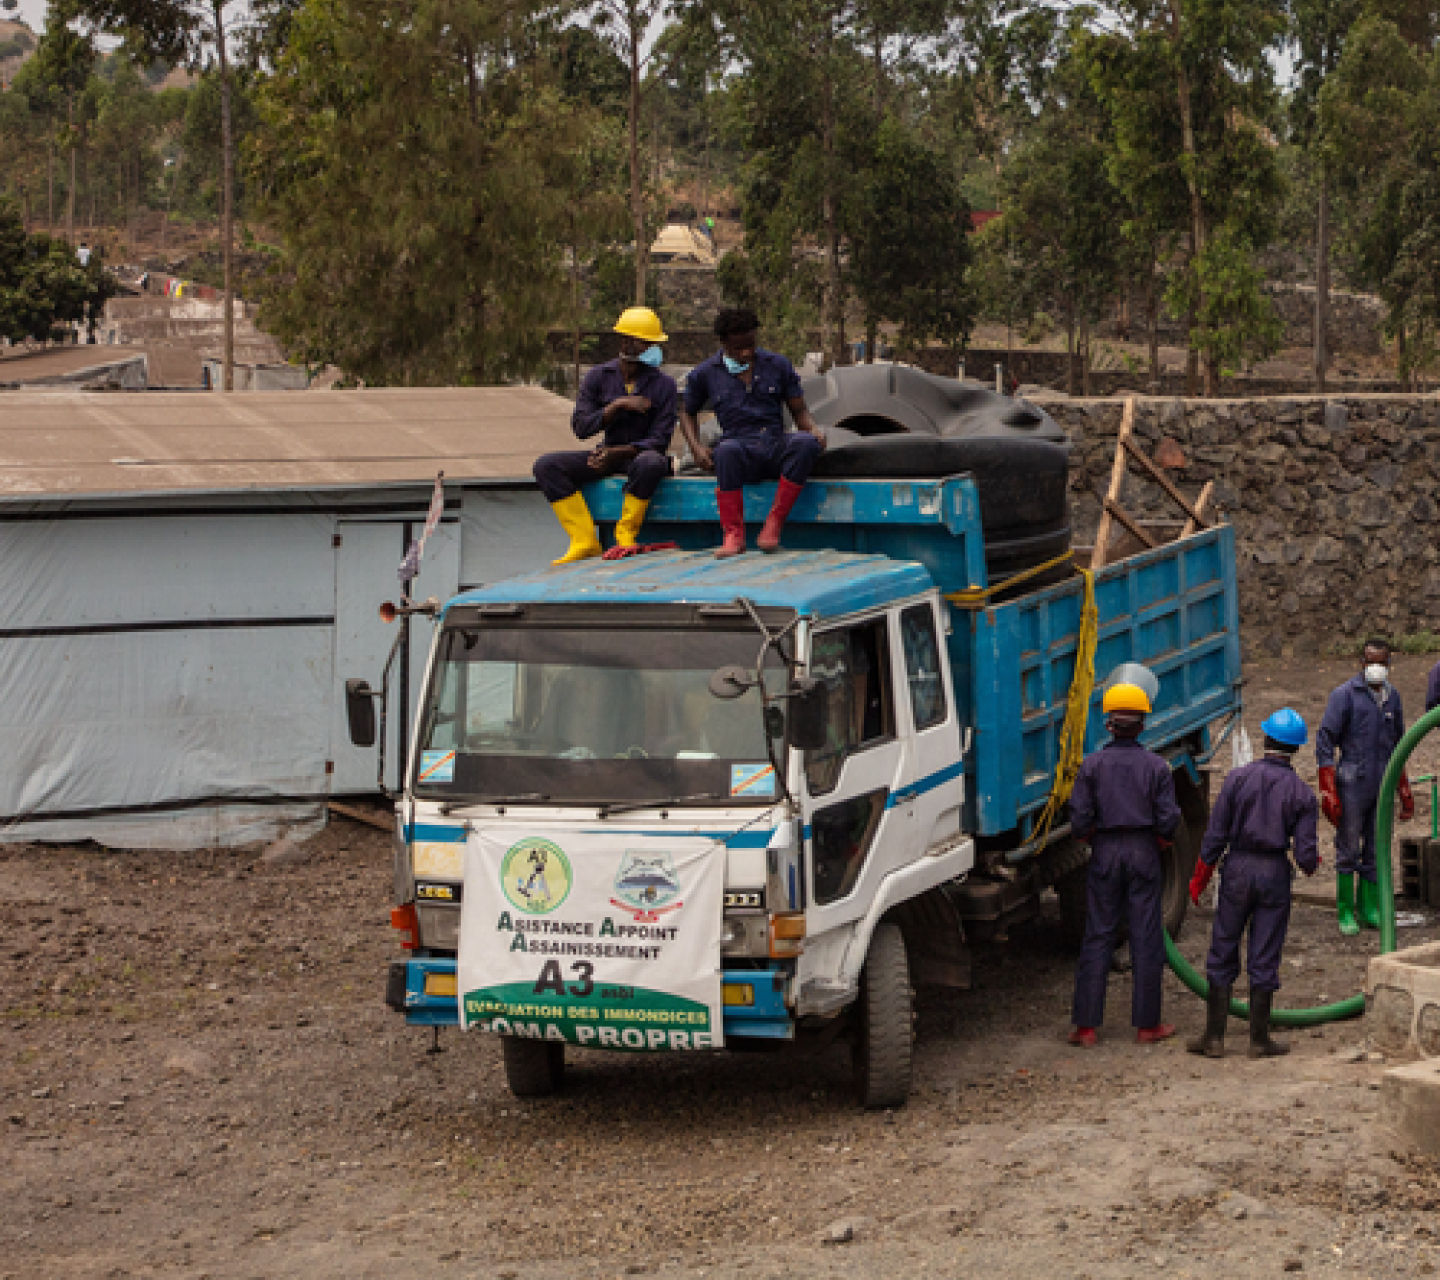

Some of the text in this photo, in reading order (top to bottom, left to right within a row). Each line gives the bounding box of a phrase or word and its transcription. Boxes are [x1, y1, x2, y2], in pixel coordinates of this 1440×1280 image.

[497, 911, 594, 937] ASISTANCE
[599, 917, 679, 940] APPOINT
[510, 933, 662, 960] ASSAINISSEMENT
[533, 960, 595, 996] A3
[567, 1006, 600, 1019] DES
[604, 1008, 707, 1024] IMMONDICES
